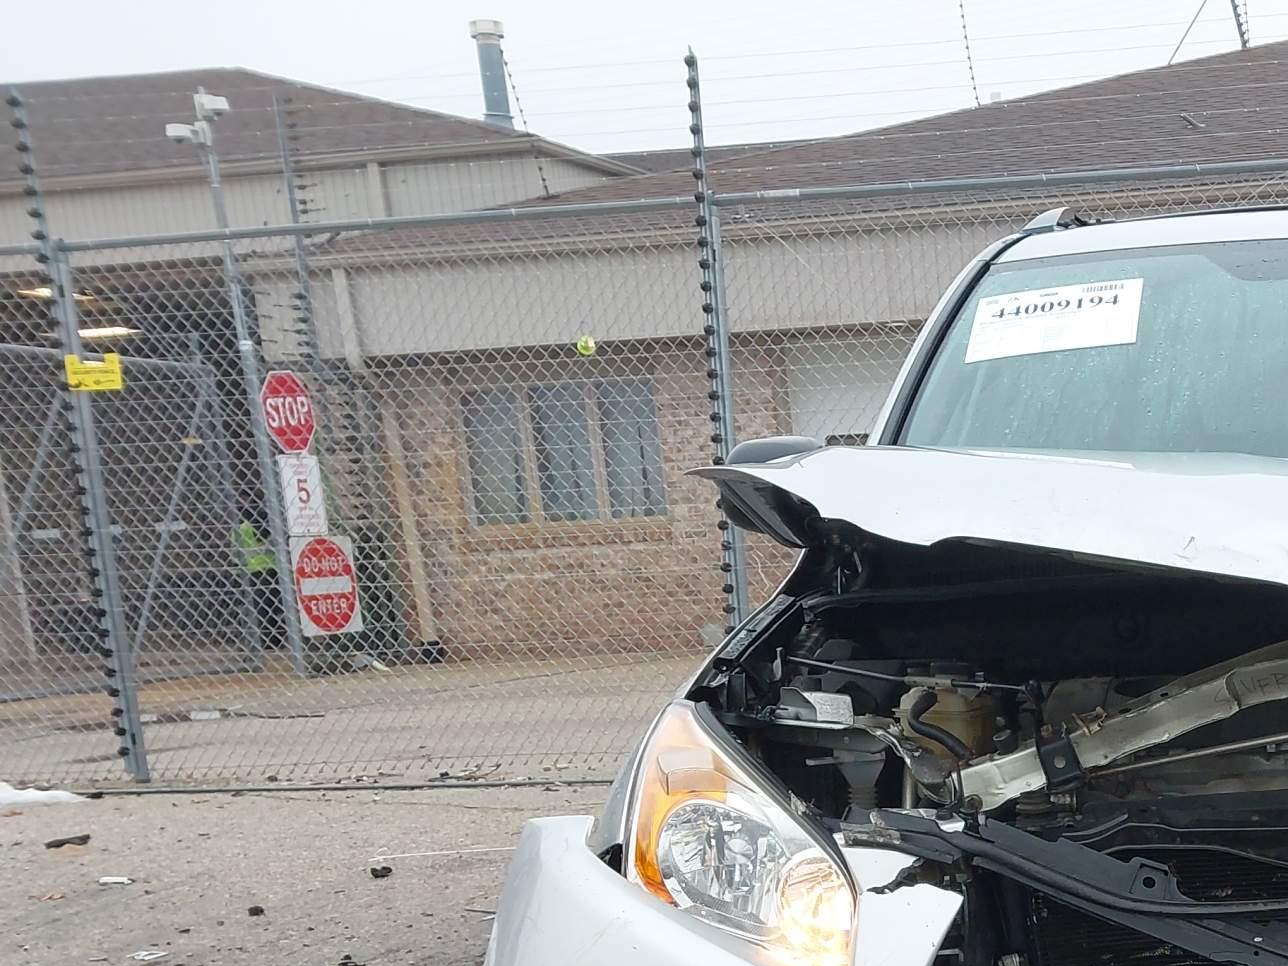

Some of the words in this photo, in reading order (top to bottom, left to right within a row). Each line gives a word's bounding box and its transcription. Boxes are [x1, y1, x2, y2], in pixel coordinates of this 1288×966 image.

[991, 294, 1119, 319] 44009194
[266, 396, 308, 427] STOP
[296, 479, 311, 505] 5
[304, 558, 320, 573] DO
[321, 557, 343, 572] NOT
[311, 598, 348, 615] ENTER
